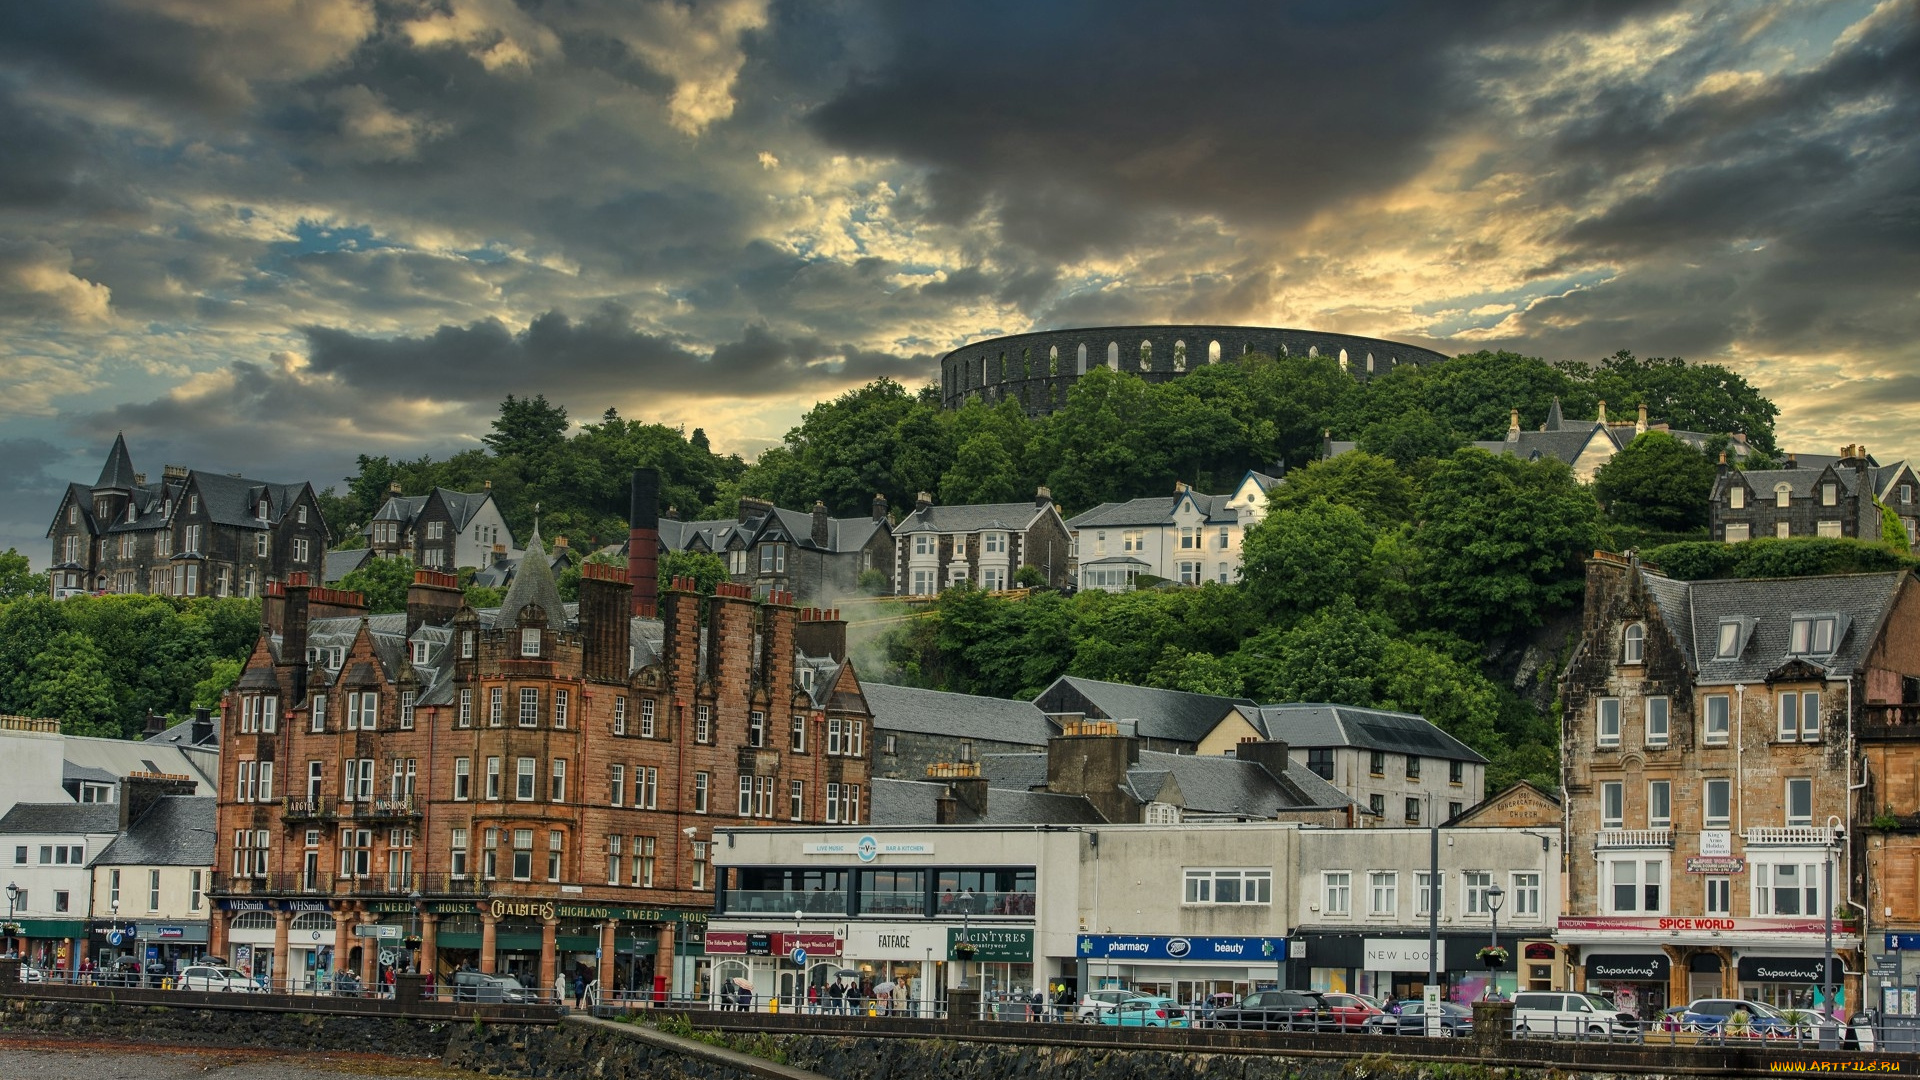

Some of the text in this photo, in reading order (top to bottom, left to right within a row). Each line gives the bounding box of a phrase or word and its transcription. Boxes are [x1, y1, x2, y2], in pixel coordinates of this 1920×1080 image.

[1509, 810, 1538, 818] CHURCH
[230, 900, 264, 910] WHSmith
[289, 901, 325, 911] WHSmith
[378, 902, 471, 913] TWEED HOUSE
[491, 900, 553, 919] CHALMERS
[561, 906, 708, 923] HIGHLAND TWEED HOUS
[1659, 918, 1735, 930] SPICE WORLD
[1807, 922, 1838, 931] CHINE
[878, 935, 910, 949] FATFACE
[1108, 941, 1150, 953] pharmacy
[1214, 942, 1244, 954] beauty
[1368, 951, 1397, 960] NEW
[1596, 965, 1654, 977] Superdrug
[1757, 967, 1819, 980] Superdrug
